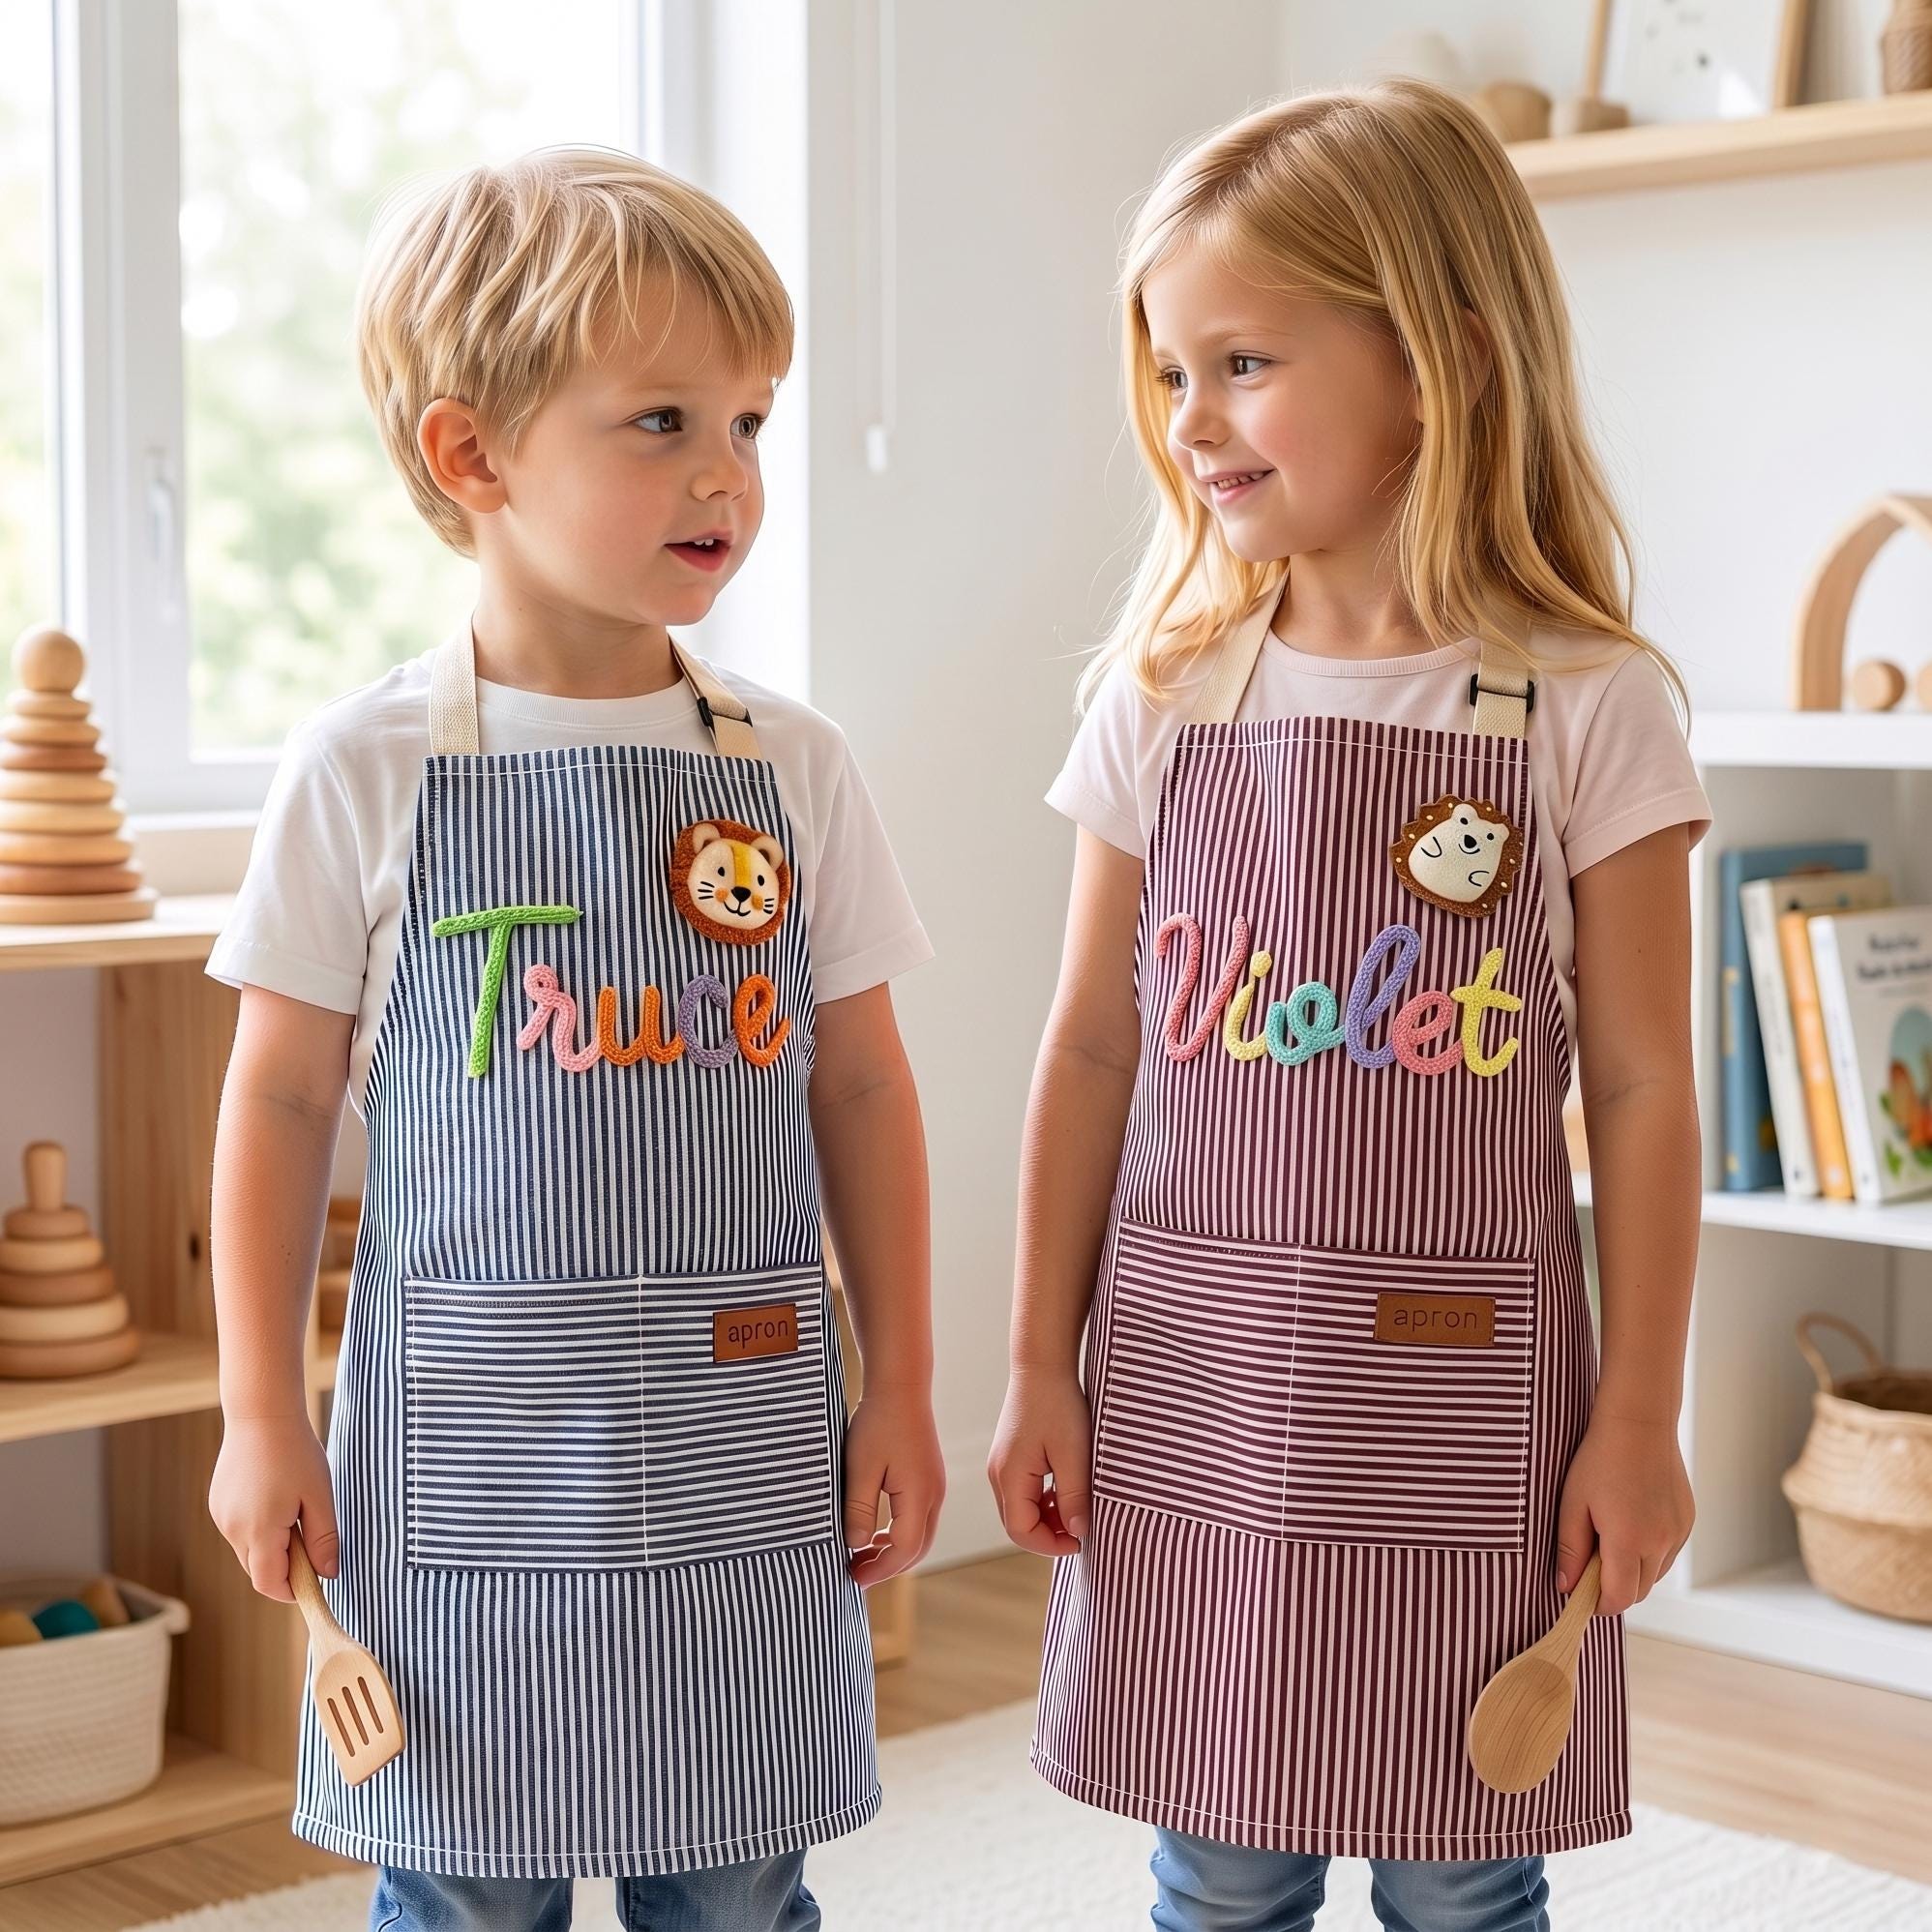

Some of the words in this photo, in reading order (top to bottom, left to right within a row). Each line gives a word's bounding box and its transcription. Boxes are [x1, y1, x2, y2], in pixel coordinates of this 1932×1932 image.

[431, 905, 791, 1078] Truce
[1156, 912, 1522, 1077] Violet
[728, 1320, 788, 1350] apron
[1393, 1309, 1477, 1332] apron
